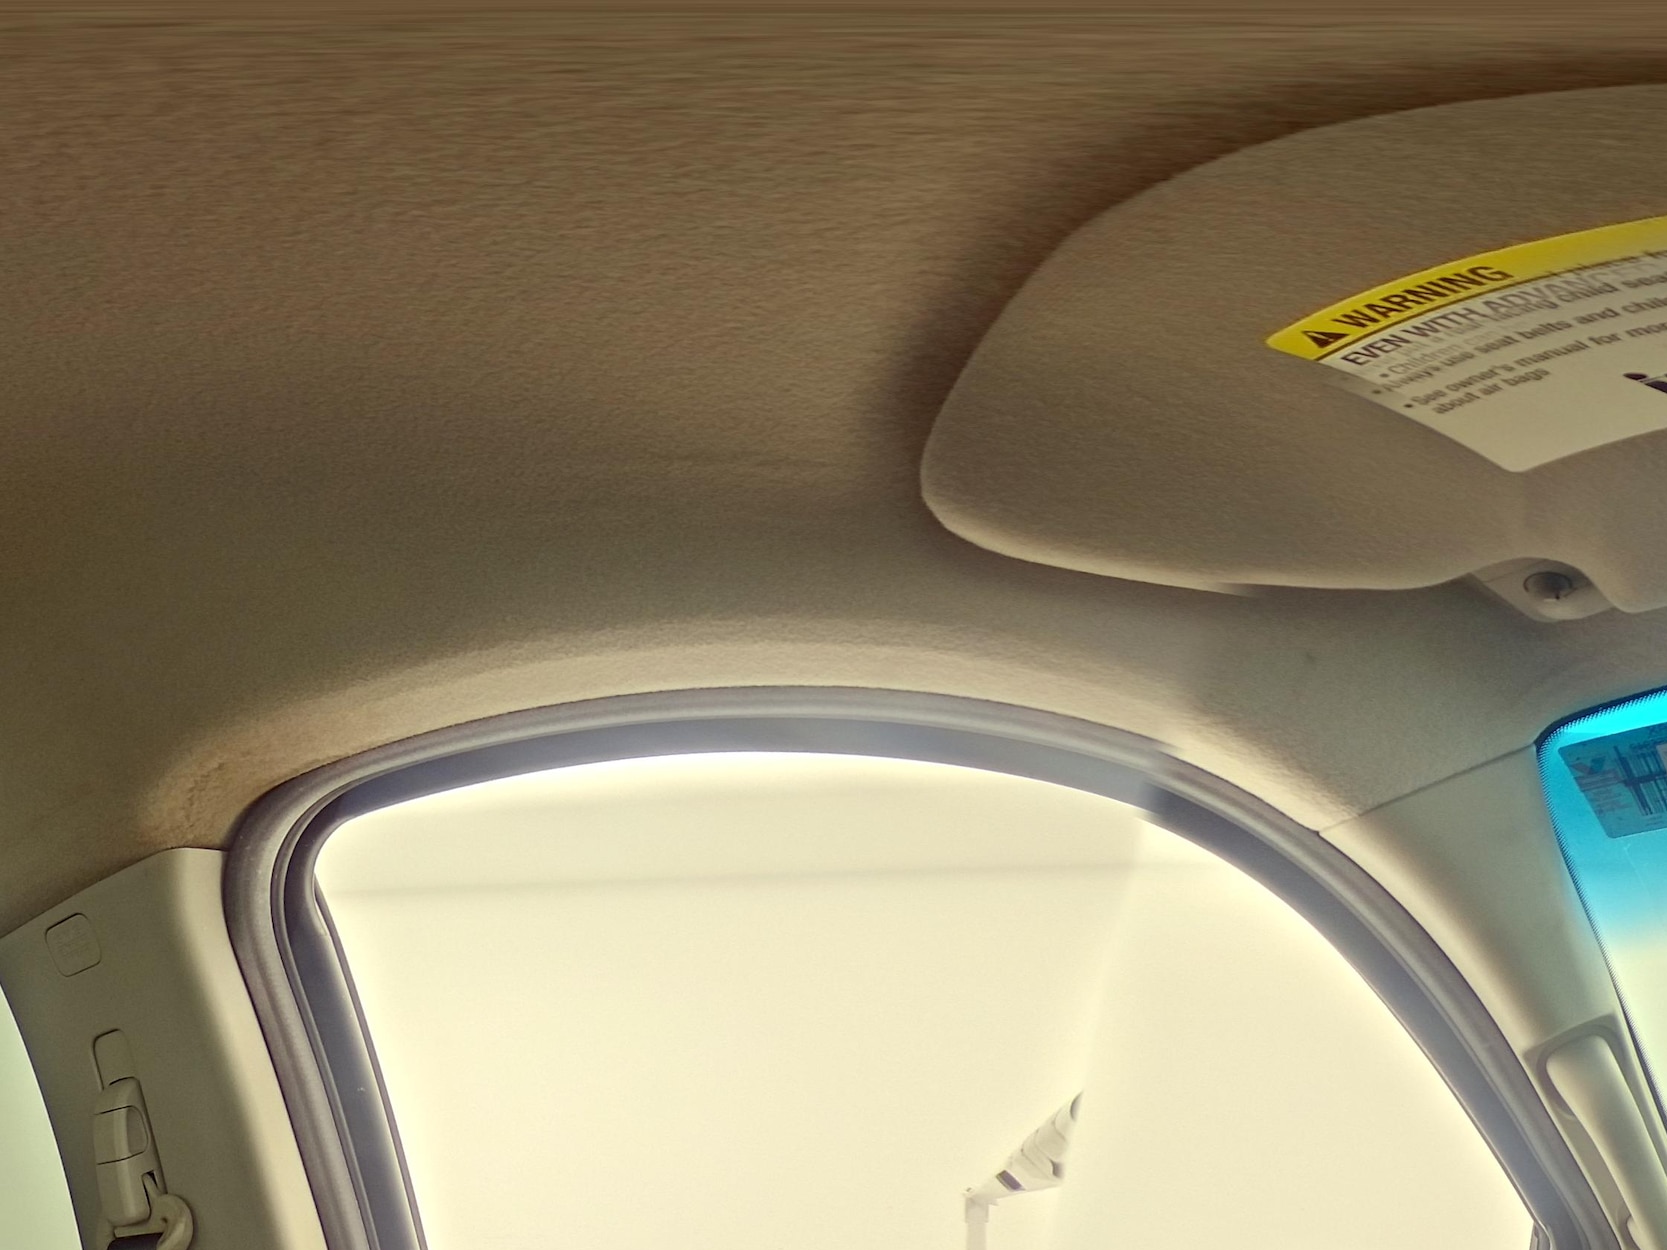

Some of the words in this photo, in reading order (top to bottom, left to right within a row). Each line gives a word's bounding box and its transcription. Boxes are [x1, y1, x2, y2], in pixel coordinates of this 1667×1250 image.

[1331, 265, 1514, 329] WARNING
[1341, 332, 1413, 367] EVEN
[1403, 306, 1488, 339] WITH
[1478, 334, 1520, 353] seat
[1516, 315, 1574, 340] belts
[1574, 307, 1621, 327] and
[1513, 338, 1590, 368] manual
[1587, 332, 1622, 348] for
[1429, 391, 1481, 414] about
[1478, 381, 1504, 396] air
[1501, 367, 1552, 389] bags
